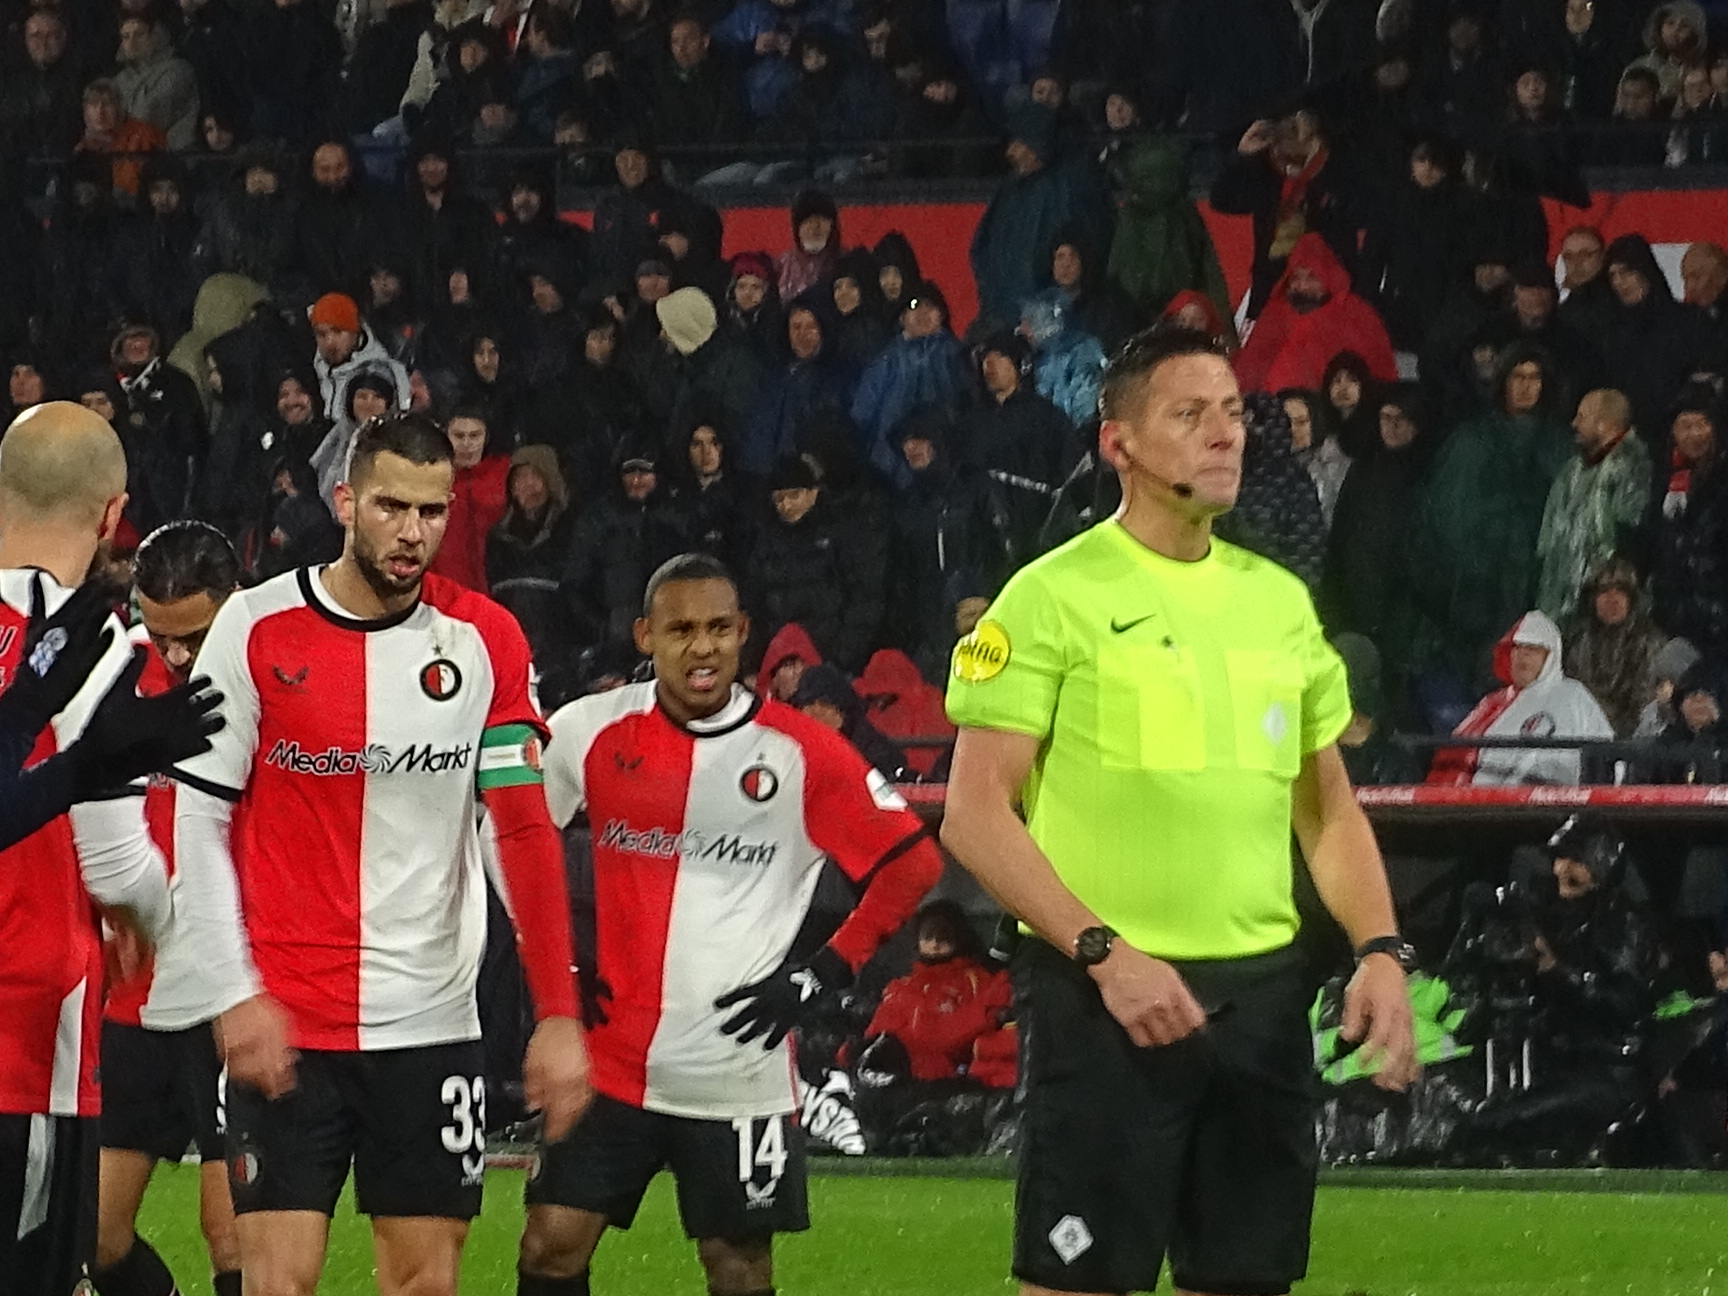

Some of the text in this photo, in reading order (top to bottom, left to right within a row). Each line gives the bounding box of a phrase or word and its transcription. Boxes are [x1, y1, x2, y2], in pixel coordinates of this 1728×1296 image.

[265, 739, 472, 775] Media Markt
[598, 817, 677, 858] Media
[732, 1115, 789, 1182] 14
